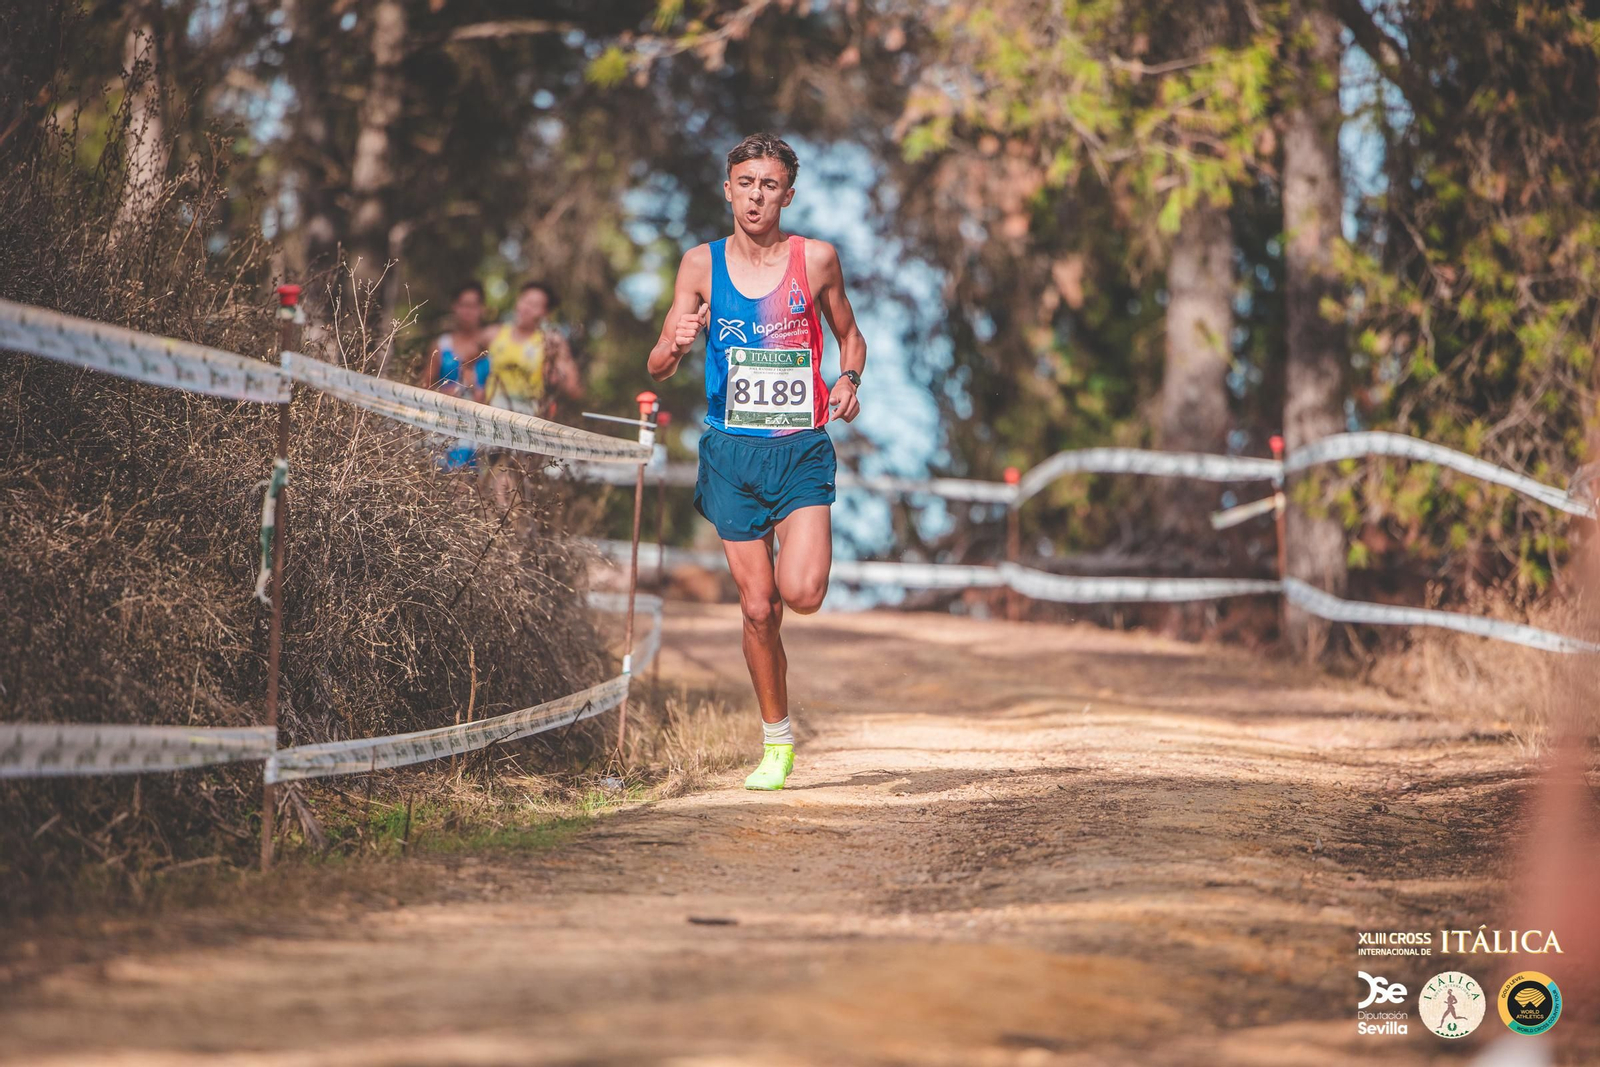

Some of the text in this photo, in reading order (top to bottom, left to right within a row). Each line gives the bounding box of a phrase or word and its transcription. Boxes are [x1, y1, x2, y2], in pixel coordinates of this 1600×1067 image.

[752, 317, 808, 336] lapalma
[751, 351, 792, 363] ITÁLICA
[734, 378, 807, 406] 8189
